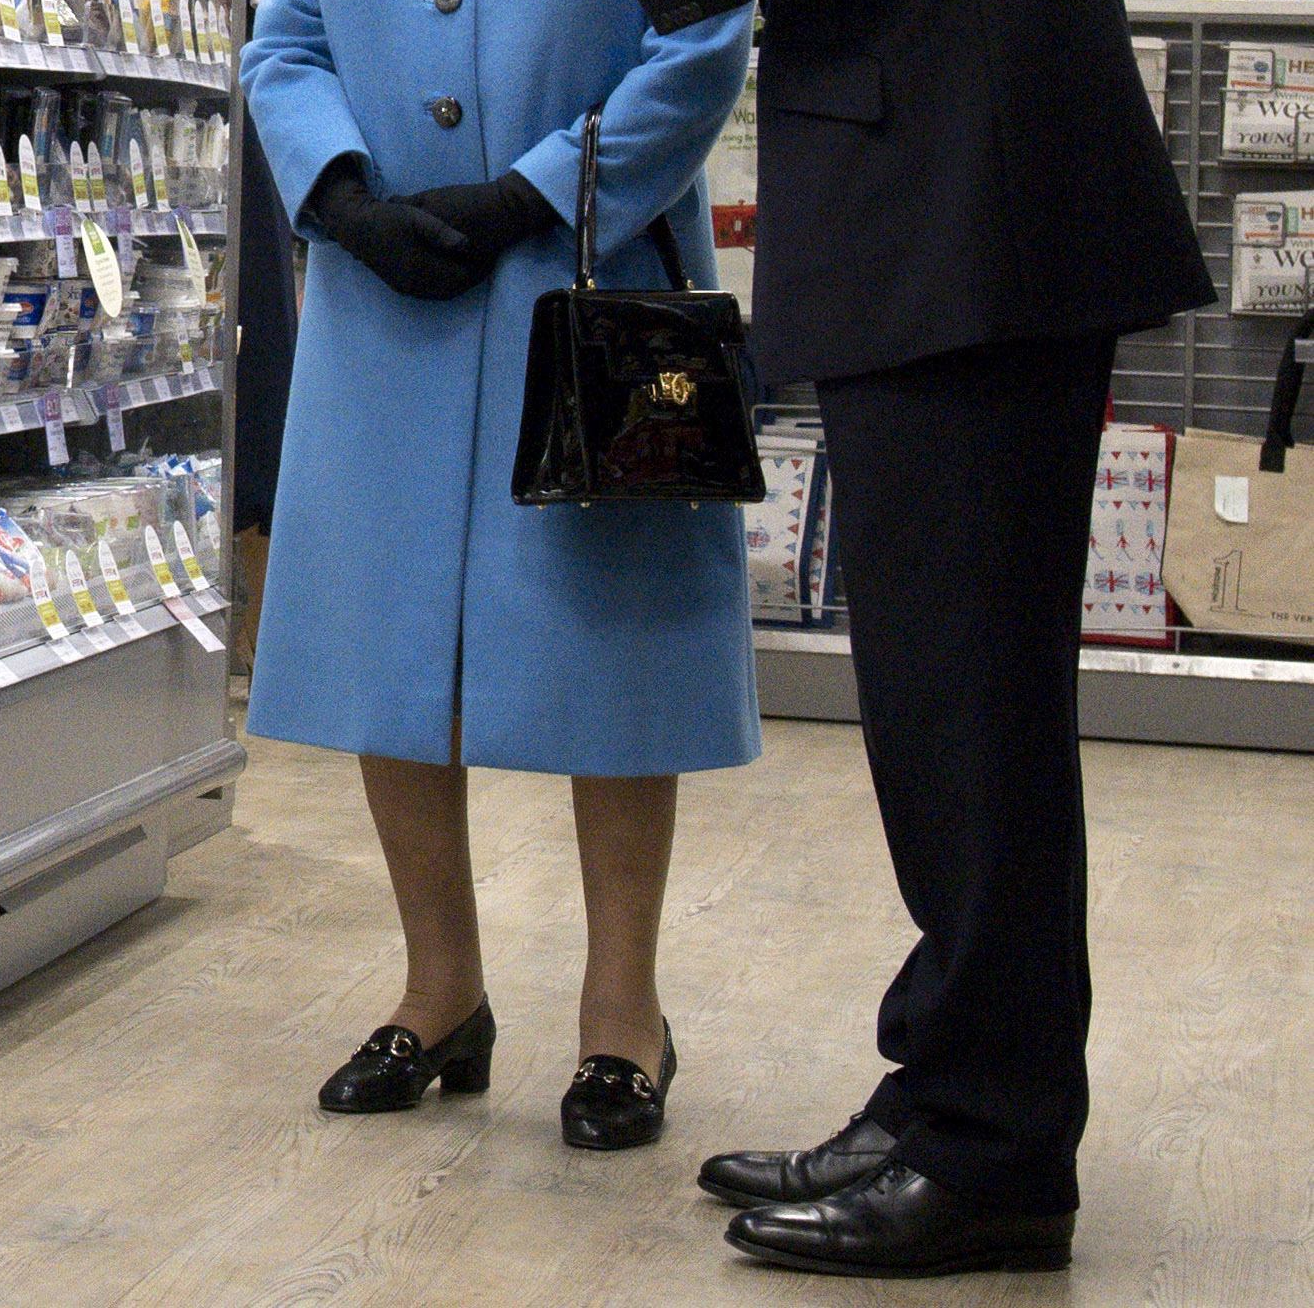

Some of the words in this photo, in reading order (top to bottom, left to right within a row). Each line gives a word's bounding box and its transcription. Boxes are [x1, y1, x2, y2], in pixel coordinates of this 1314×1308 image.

[1288, 59, 1314, 74] HE
[733, 107, 755, 124] Wa
[1257, 99, 1314, 120] Wee
[1301, 206, 1314, 220] H
[1274, 250, 1314, 268] We
[1293, 613, 1314, 624] VER
